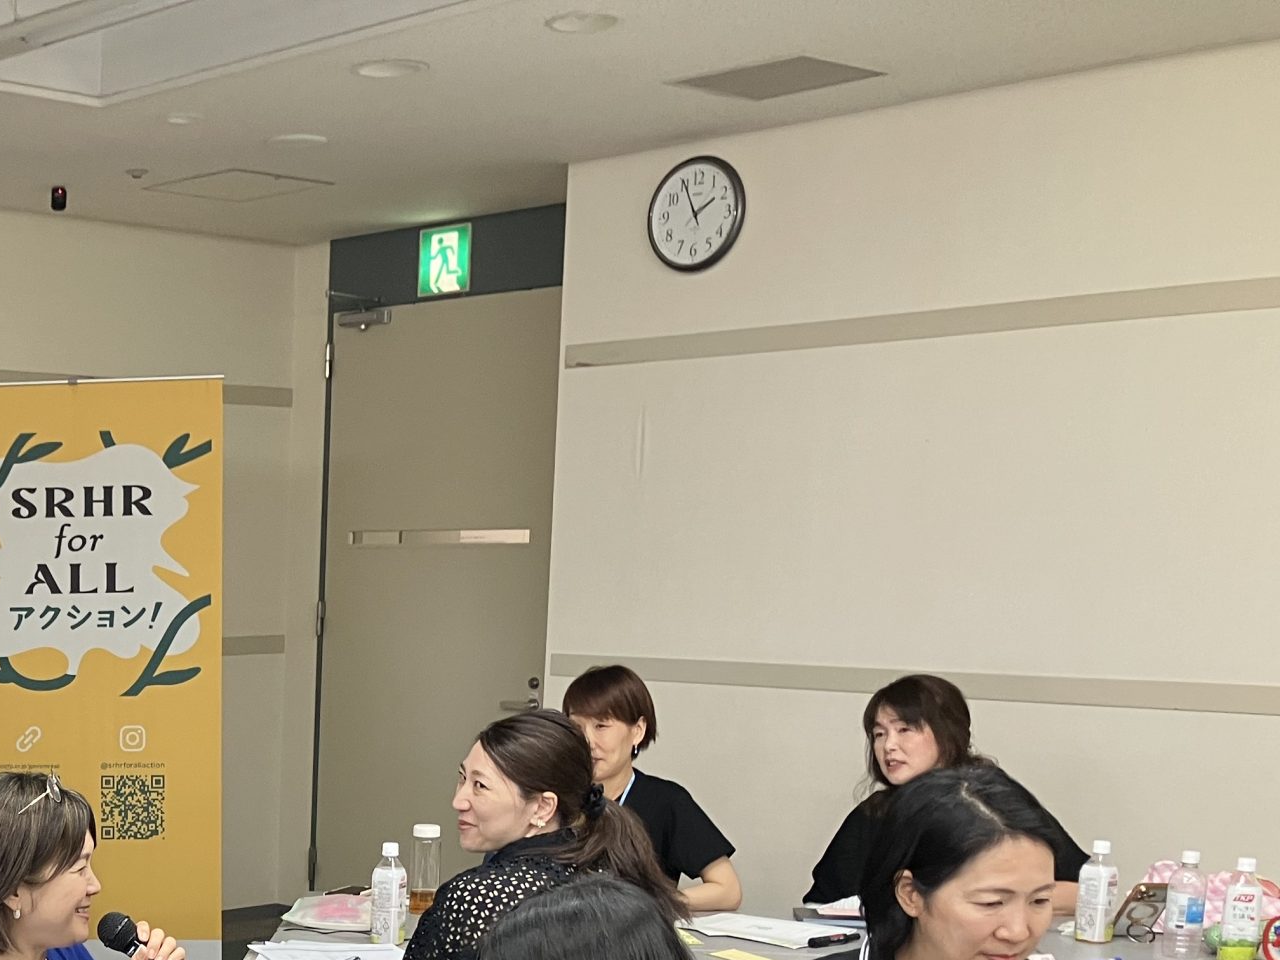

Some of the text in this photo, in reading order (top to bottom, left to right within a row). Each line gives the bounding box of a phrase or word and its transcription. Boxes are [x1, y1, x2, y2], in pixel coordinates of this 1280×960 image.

[693, 169, 705, 186] 12
[668, 192, 679, 207] 10
[720, 185, 728, 200] 2
[662, 211, 670, 224] 9
[724, 204, 731, 219] 3
[665, 229, 673, 242] 8
[715, 223, 723, 238] 4
[677, 240, 684, 255] 7
[689, 243, 697, 257] 6
[705, 237, 712, 252] 5
[11, 484, 153, 519] SRHR
[54, 523, 104, 559] for
[24, 562, 135, 595] ALL
[9, 602, 164, 631] アクション!
[100, 761, 166, 770] @srhrforallaction
